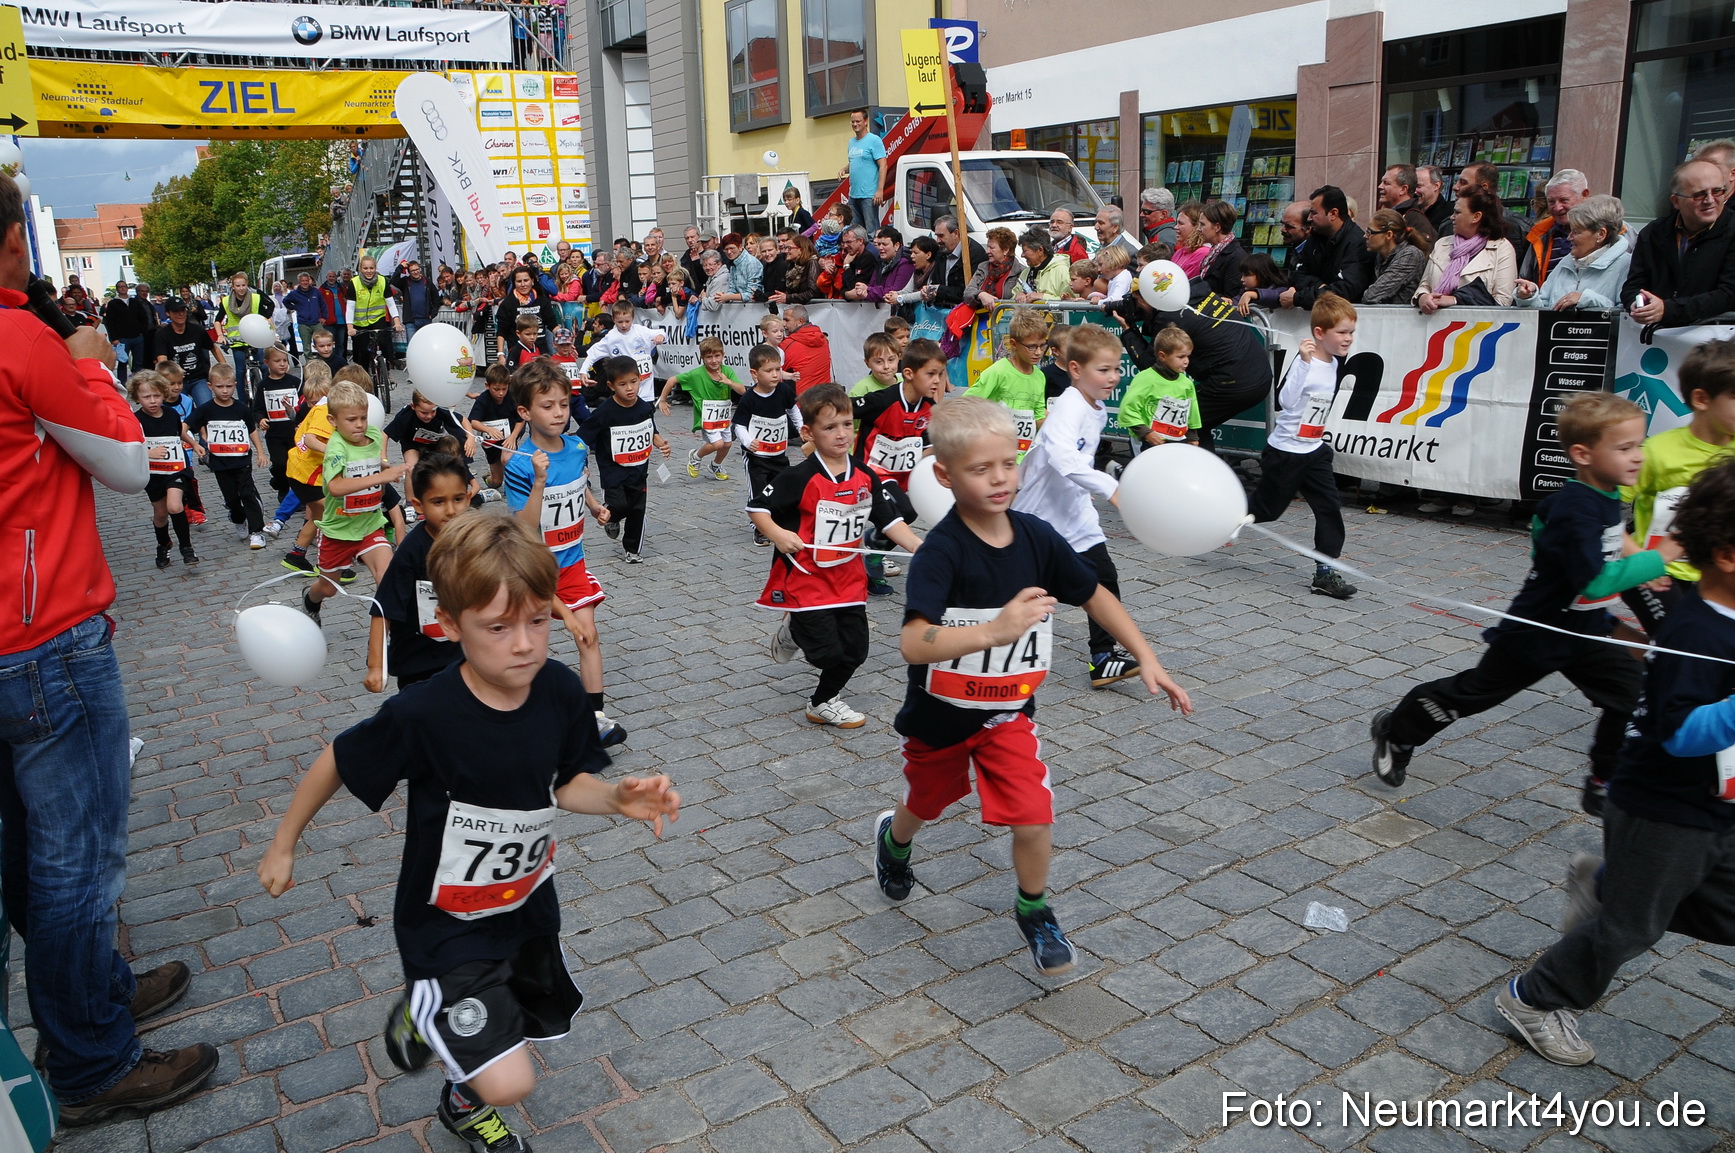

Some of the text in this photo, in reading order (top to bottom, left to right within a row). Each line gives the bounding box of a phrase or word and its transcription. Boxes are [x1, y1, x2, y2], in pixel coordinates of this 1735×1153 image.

[20, 6, 187, 37] MW Laufsport
[329, 24, 470, 46] BMW Laufsport
[904, 52, 941, 68] Jugend
[917, 69, 937, 83] lauf
[41, 92, 144, 107] Neumarkter Stadtlauf
[199, 80, 296, 114] ZIEL
[344, 99, 390, 109] Neumarkter
[992, 87, 1032, 105] erer Markt 15
[447, 151, 492, 237] Audi BKK
[1567, 326, 1592, 335] Strom
[662, 351, 747, 368] Weniger Vauch.
[1563, 352, 1588, 361] Erdgas
[1557, 377, 1586, 387] Wasser
[268, 396, 296, 410] 717
[706, 408, 730, 421] 7148
[211, 429, 246, 443] 7143
[628, 425, 649, 435] Neumarkt
[754, 425, 786, 443] 7237
[1016, 421, 1033, 438] 35
[616, 432, 652, 453] 7239
[1321, 427, 1440, 464] eumarkt
[1540, 453, 1572, 465] Stadtbu
[346, 465, 366, 473] PARTL
[548, 493, 586, 528] 712
[818, 506, 843, 517] PARTL
[825, 514, 865, 543] 715
[964, 680, 1018, 698] Simon
[451, 815, 508, 834] PARTL
[463, 832, 550, 883] 739
